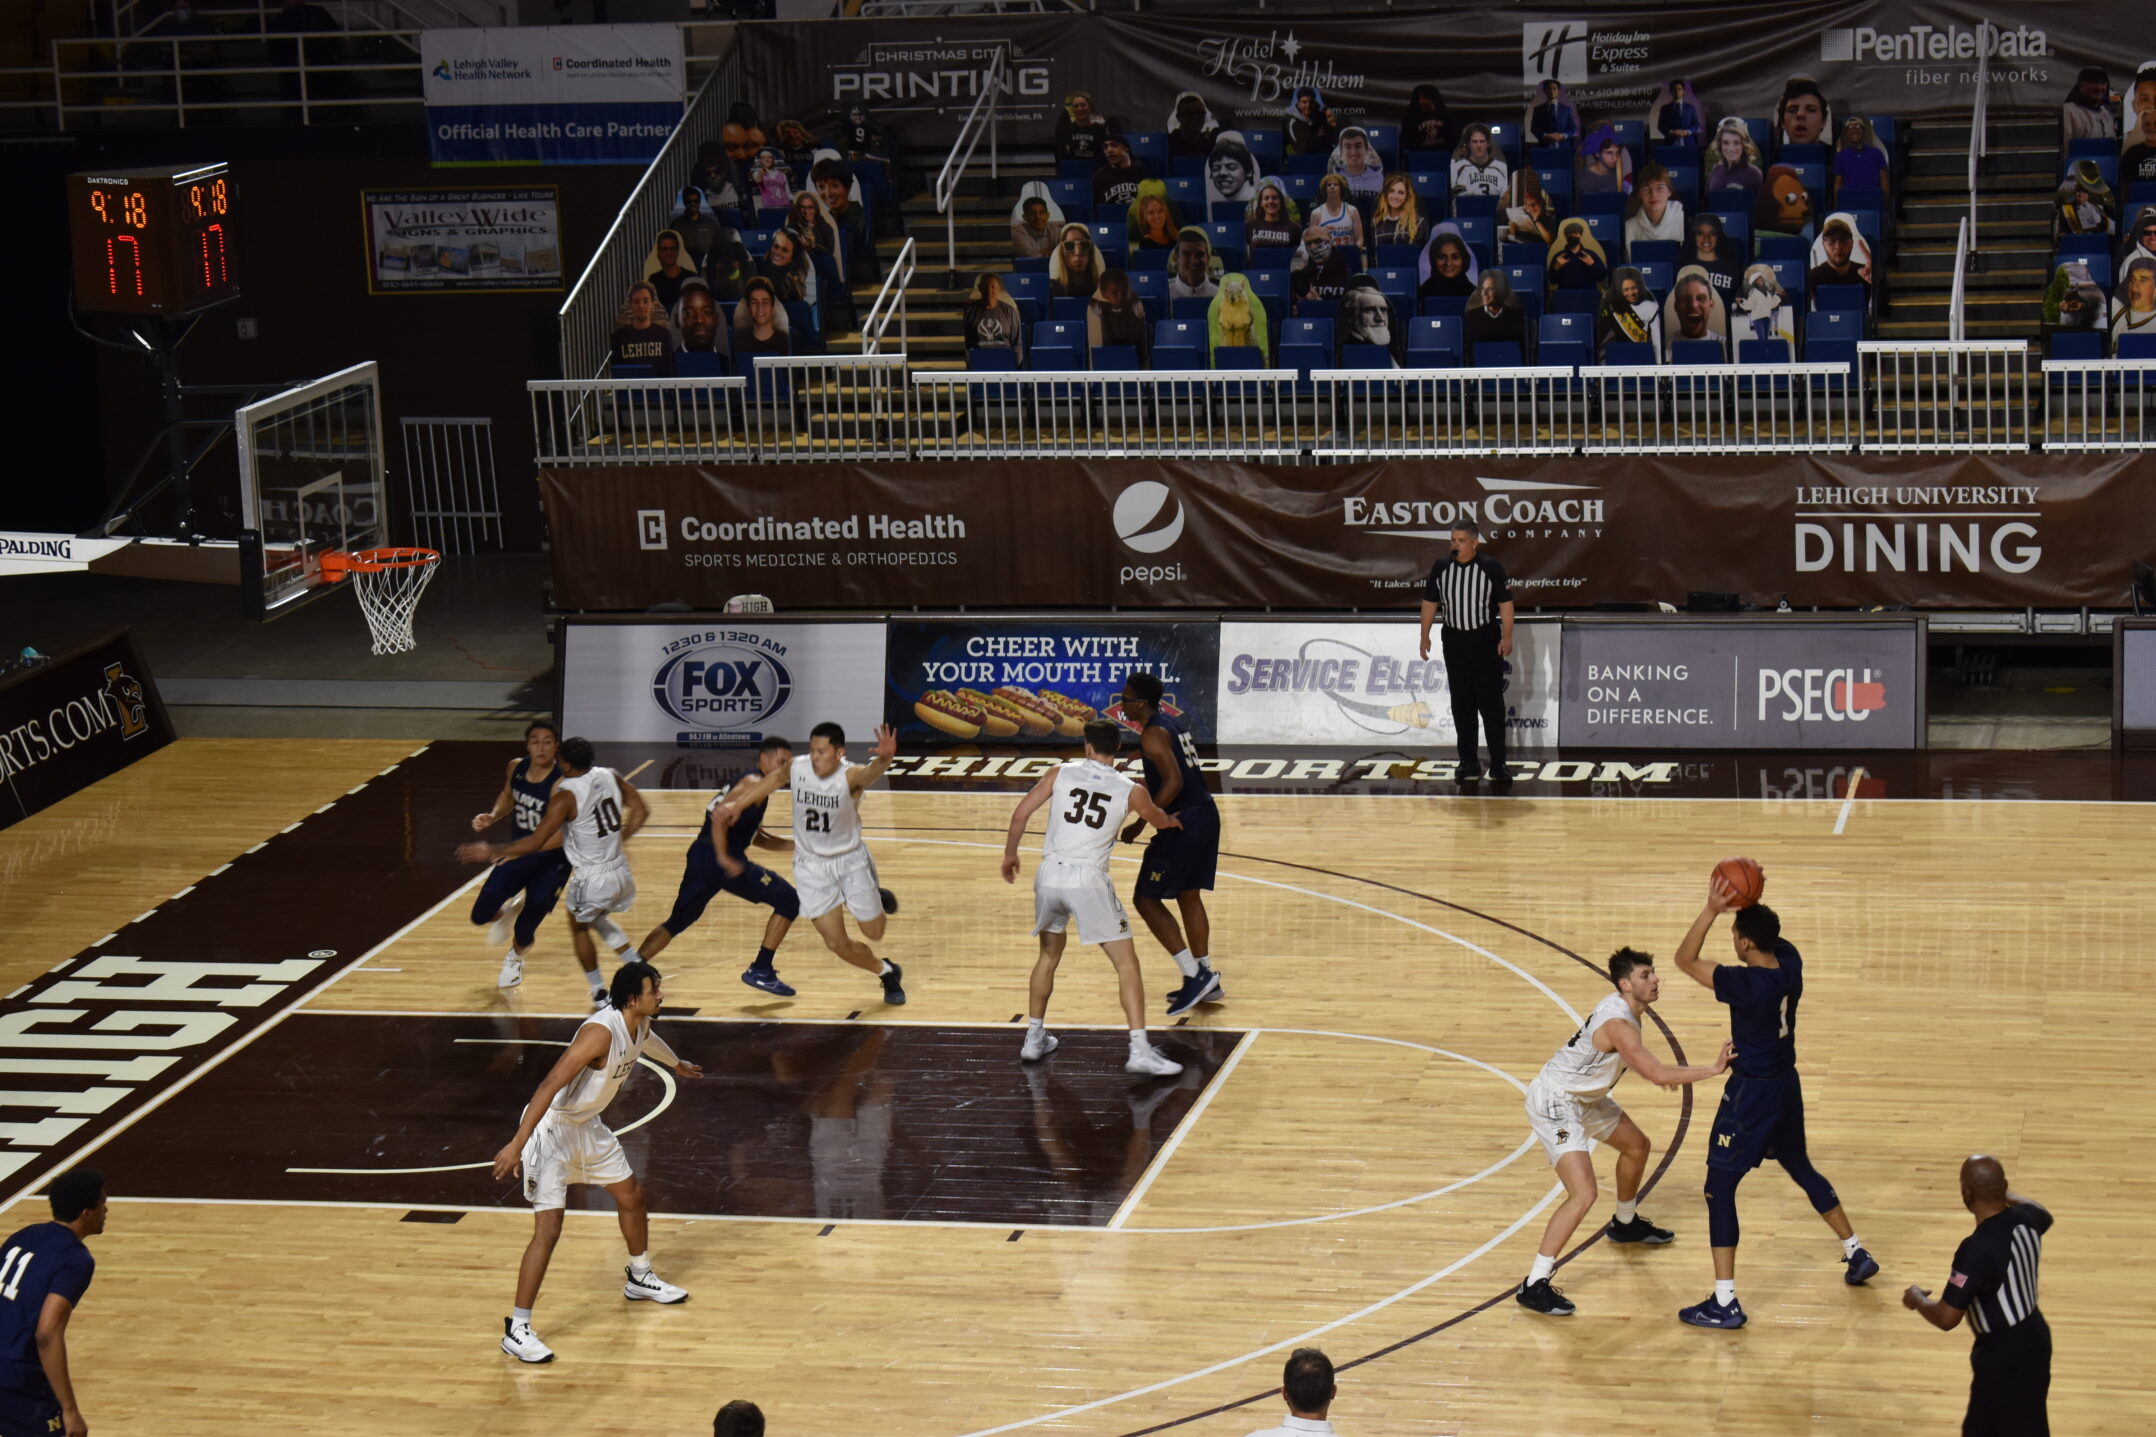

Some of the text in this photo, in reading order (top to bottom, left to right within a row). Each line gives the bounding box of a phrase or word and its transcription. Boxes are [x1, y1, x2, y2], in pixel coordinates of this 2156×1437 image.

[1591, 30, 1650, 44] Holiday Inn
[1855, 24, 2047, 61] PenTeleData
[566, 57, 671, 69] Coordinated Health
[875, 48, 1005, 62] CHRISTMAS CIT
[1197, 29, 1277, 77] Hotel
[1592, 46, 1649, 62] Express
[454, 58, 518, 71] Lehigh Valley
[454, 69, 531, 80] Health Network
[1600, 62, 1640, 72] & Suites
[833, 67, 1049, 101] PRINTING
[1233, 60, 1365, 102] Bethlehem
[1906, 68, 1951, 85] fiber
[438, 121, 671, 141] Official Health Care Partner
[87, 177, 129, 186] DAKTRONICS
[1469, 174, 1498, 187] LEHIGH
[1479, 184, 1490, 196] 3
[90, 190, 147, 229] 9:18
[395, 227, 548, 237] SIGNS & GRAPHICS
[1252, 230, 1290, 242] LEHIGH
[107, 235, 143, 296] 17
[201, 223, 228, 288] 17
[621, 341, 662, 359] LEHIGH
[1796, 486, 2040, 504] LEHIGH UNIVERSITY
[1343, 494, 1604, 526] EASTON COACH
[681, 514, 965, 542] Coordinated Health
[1490, 529, 1602, 540] COMPANY
[0, 539, 71, 559] PALDING
[1795, 522, 2042, 574] DINING
[684, 552, 957, 567] SPORTS MEDICINE & ORTHOPEDICS
[1120, 563, 1182, 585] pepsi
[1384, 579, 1411, 588] takes
[1413, 579, 1427, 588] all
[1525, 577, 1562, 589] perfect
[1563, 577, 1587, 588] trip"
[662, 631, 787, 656] 1230 & 1320 AM
[966, 636, 1139, 657] CHEER WITH
[683, 661, 762, 697] FOX
[922, 662, 995, 683] YOUR
[1001, 662, 1101, 683] MOUTH
[1227, 653, 1359, 695] SERVICE
[1587, 664, 1689, 681] BANKING
[1587, 687, 1642, 703] ON A
[1759, 668, 1871, 722] PSECU
[681, 699, 763, 712] SPORTS
[1587, 708, 1714, 725] DIFFERENCE.
[689, 733, 702, 741] 94.7
[703, 733, 712, 741] FM
[719, 733, 751, 741] Allentown
[1178, 731, 1200, 769] 55
[797, 789, 840, 809] LEHIGH
[1063, 787, 1112, 830] 35
[515, 804, 542, 832] 20
[593, 797, 622, 839] 10
[805, 808, 831, 834] 21
[1151, 871, 1162, 883] N
[1778, 995, 1789, 1039] 1
[1716, 1133, 1731, 1149] N
[0, 1245, 35, 1302] 11
[47, 1415, 62, 1432] N
